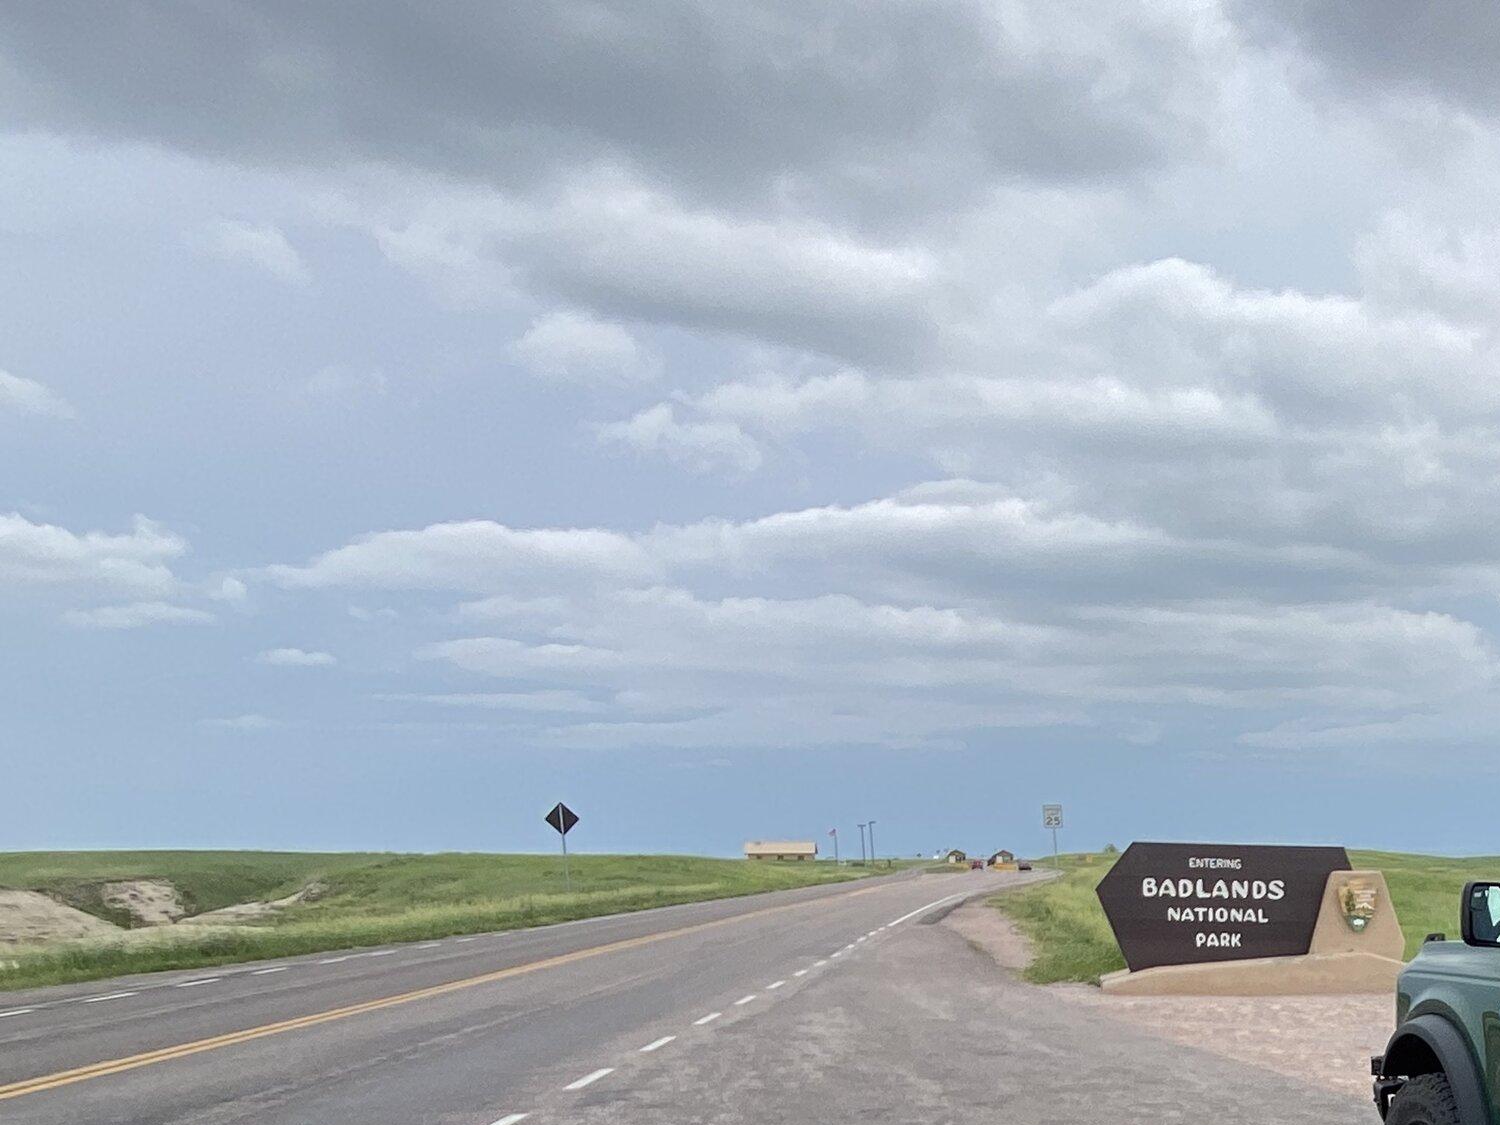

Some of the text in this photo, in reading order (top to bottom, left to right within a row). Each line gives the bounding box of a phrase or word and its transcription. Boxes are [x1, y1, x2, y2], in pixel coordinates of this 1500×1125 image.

[1046, 816, 1061, 826] 25
[1188, 857, 1242, 870] ENTERING
[1142, 877, 1285, 900] BADLANDS
[1167, 906, 1269, 924] NATIONAL
[1195, 932, 1242, 948] PARK
